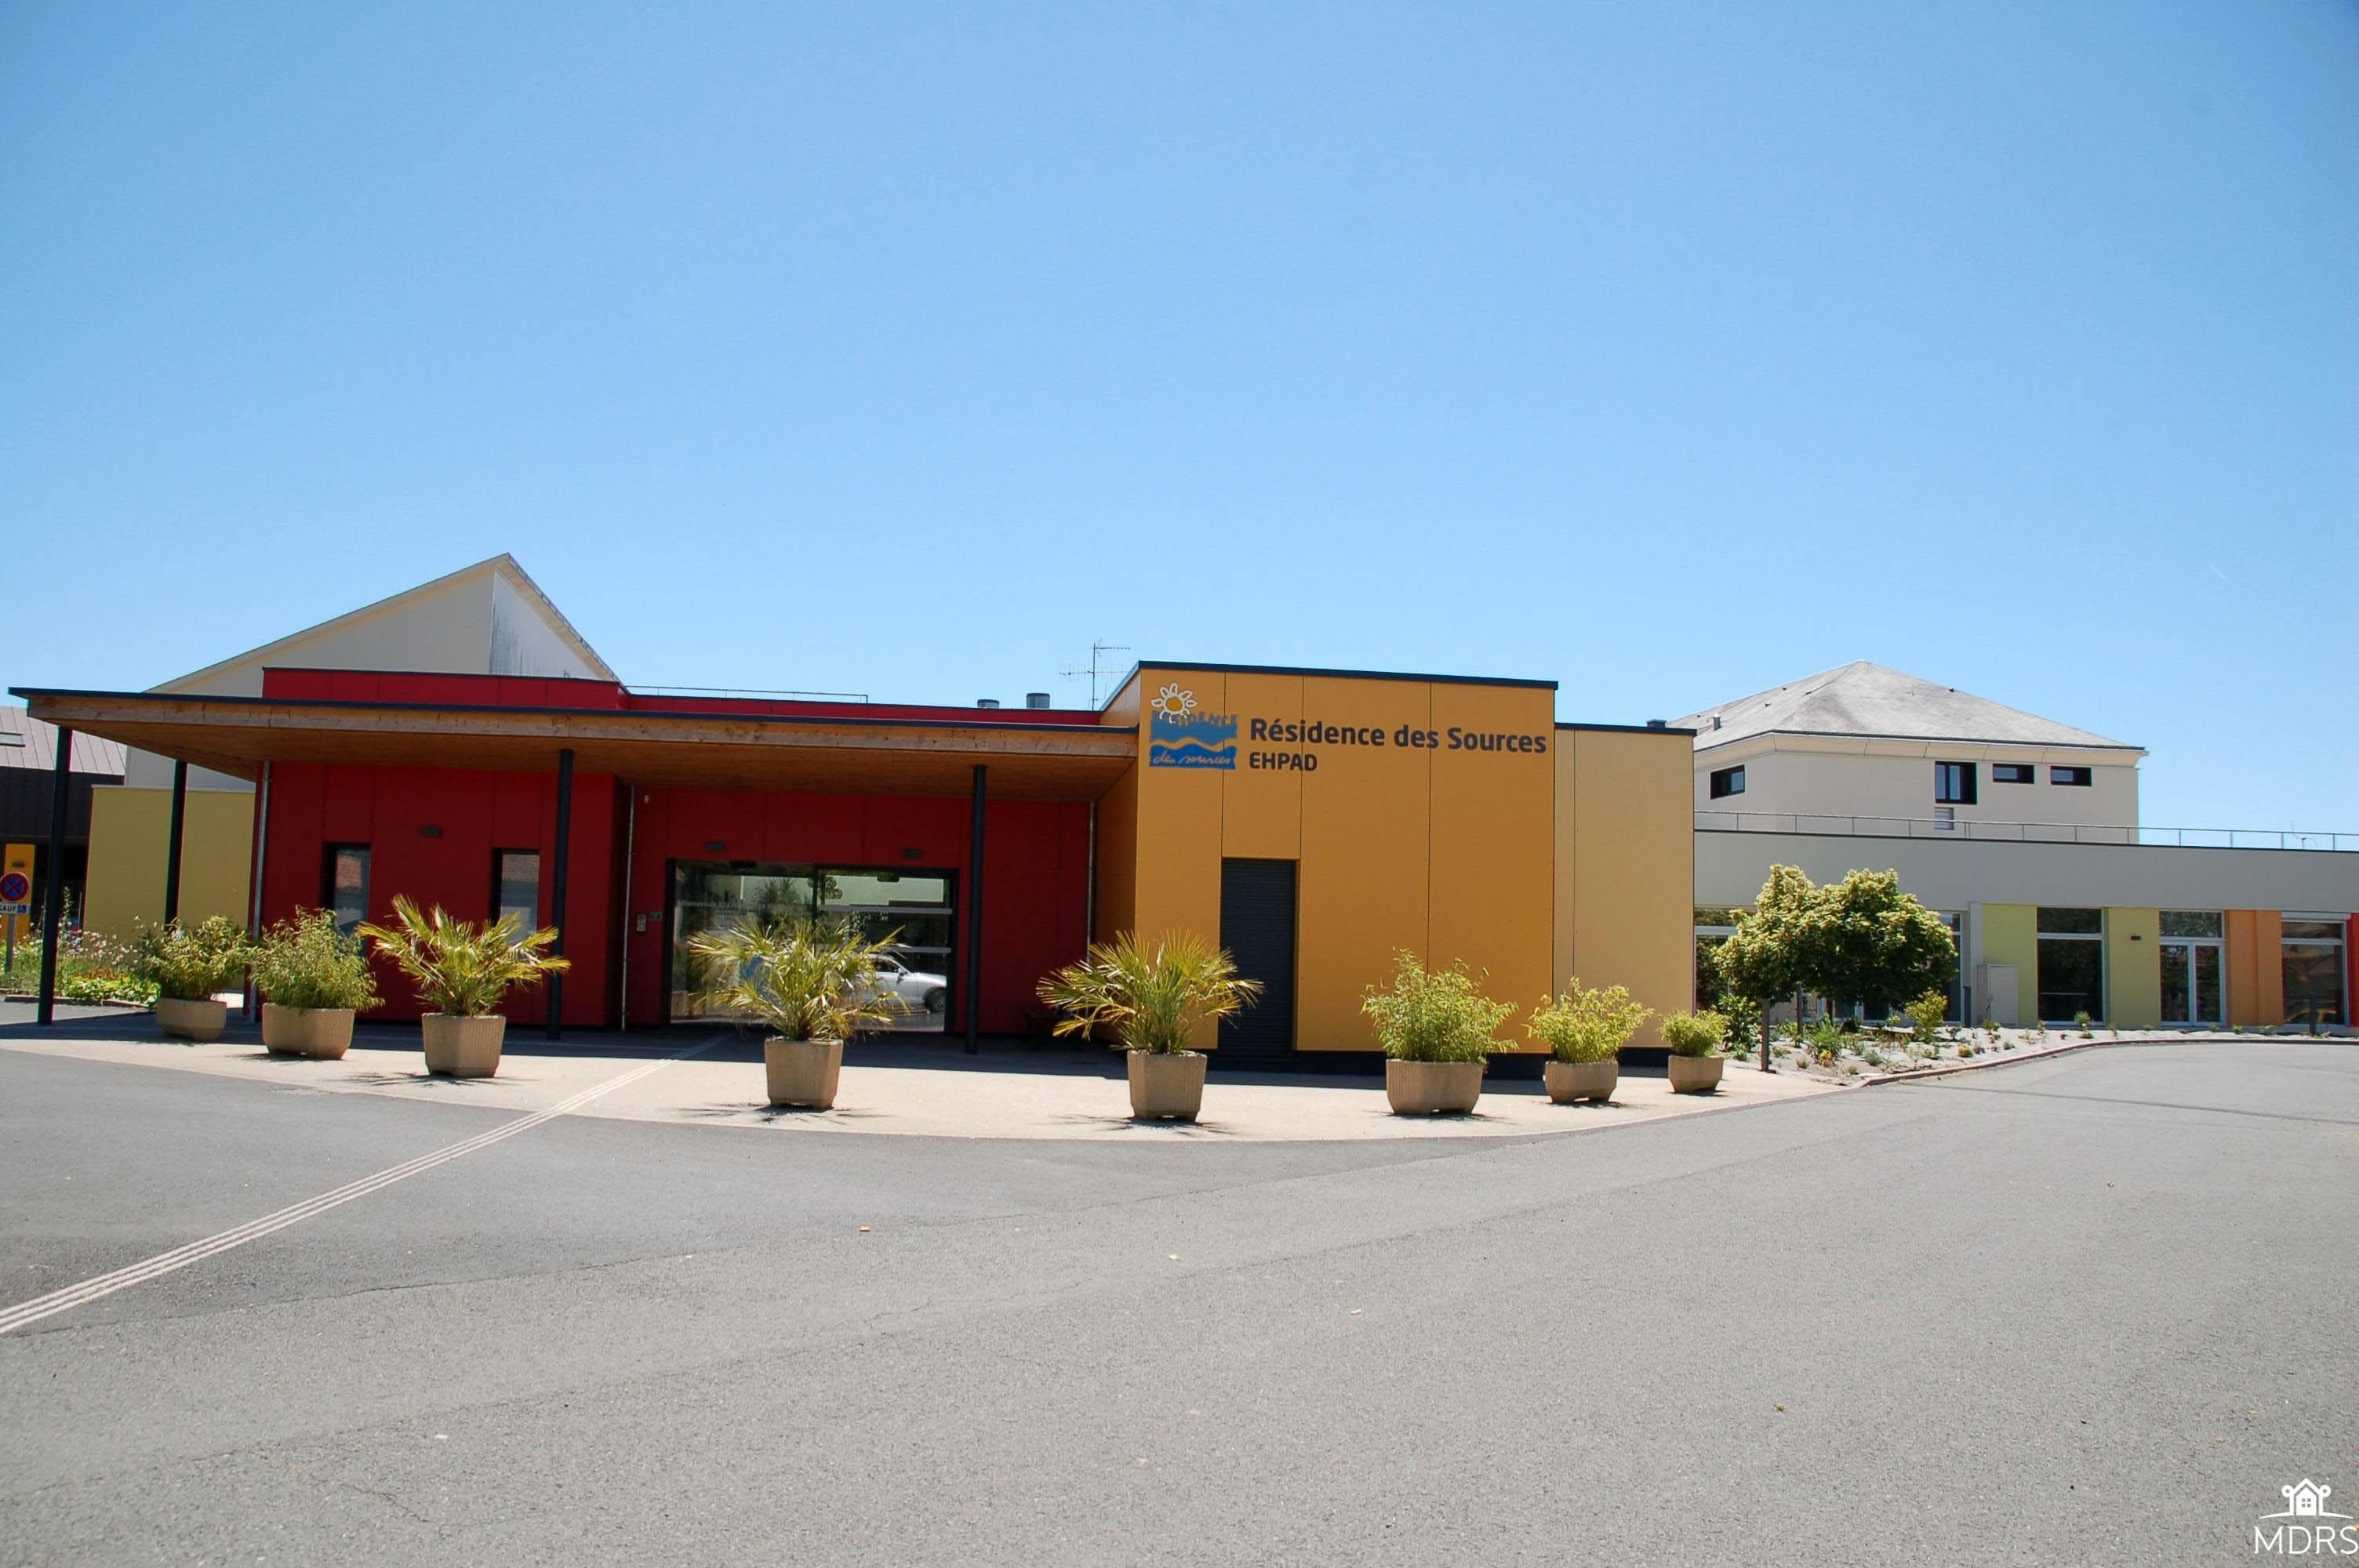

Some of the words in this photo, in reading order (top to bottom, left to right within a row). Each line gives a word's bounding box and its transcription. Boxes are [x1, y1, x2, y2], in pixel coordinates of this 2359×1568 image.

[1250, 717, 1386, 746] Résidence
[1394, 724, 1439, 749] des
[1447, 727, 1547, 753] Sources
[1249, 752, 1318, 771] EHPAD
